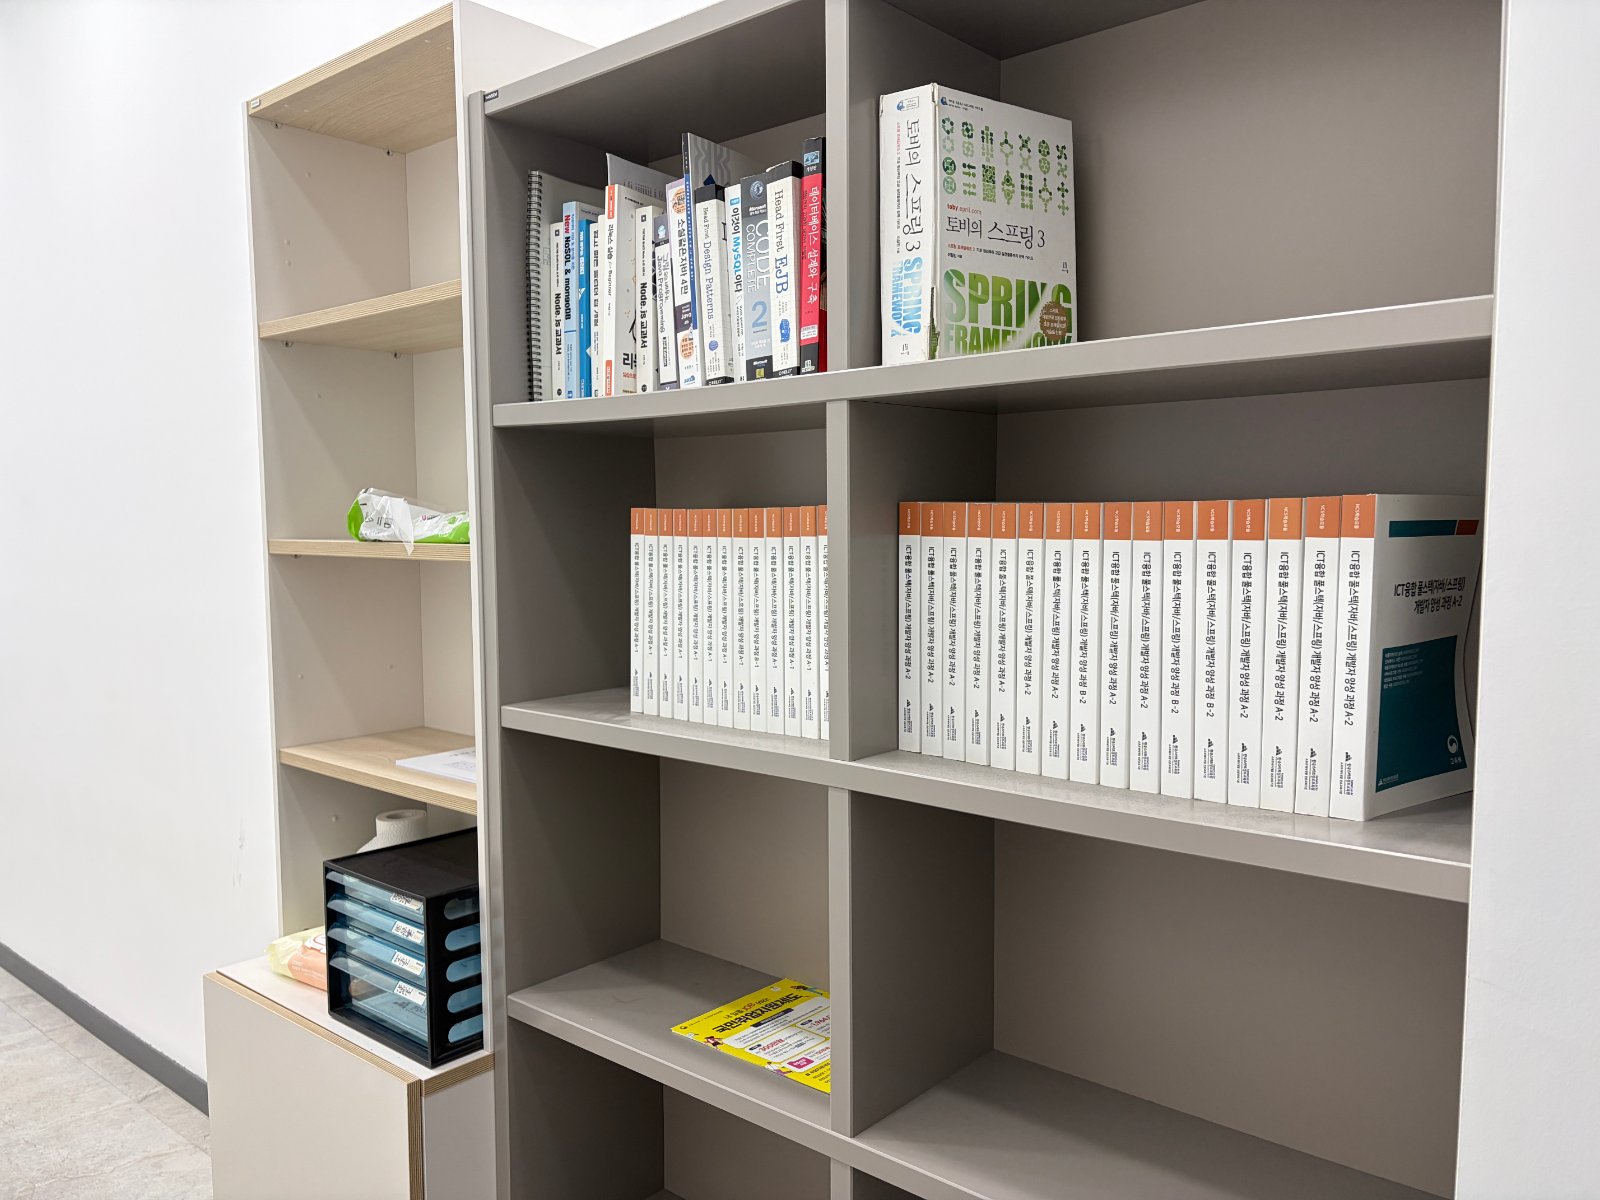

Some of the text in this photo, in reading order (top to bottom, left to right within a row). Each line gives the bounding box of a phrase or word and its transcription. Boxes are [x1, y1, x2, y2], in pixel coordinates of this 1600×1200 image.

[904, 119, 921, 167] 토비의
[902, 172, 924, 235] 스프링
[702, 207, 710, 223] Head
[807, 186, 819, 245] 데이터베이스
[774, 189, 788, 294] Head First EJB
[946, 216, 1045, 249] 토비의 스프링 3
[731, 207, 743, 293] 이것이 MySQL이다
[755, 219, 771, 290] CODE
[905, 241, 921, 252] 3
[702, 241, 713, 274] Design
[746, 224, 757, 293] COMPLETE
[807, 247, 819, 278] 설계와
[680, 278, 689, 295] 4판
[903, 256, 924, 335] SPRING
[657, 278, 665, 333] Programming
[705, 277, 715, 320] Patterns
[944, 268, 1073, 335] SPRING
[640, 282, 648, 348] Node.js 교과서
[751, 300, 767, 328] 2
[904, 544, 912, 566] ICT융합
[1141, 551, 1151, 577] ICT융합
[1172, 551, 1182, 577] ICT융합
[1314, 550, 1326, 578] ICT융합
[1206, 551, 1216, 578] ICT융합
[1241, 552, 1252, 579] ICT융합
[1278, 551, 1289, 579] ICT융합
[1348, 550, 1360, 579] ICT융합
[1394, 580, 1417, 597] ICT융합
[1414, 594, 1462, 615] 개발자 양성 과정 A-2
[633, 621, 639, 632] 양성
[904, 623, 912, 641] 개발자
[633, 632, 639, 642] 과정
[753, 633, 759, 644] 양성
[805, 635, 811, 647] 양성
[753, 645, 759, 656] 과정
[805, 648, 812, 659] 과정
[904, 642, 911, 654] 양성
[1140, 643, 1150, 664] 개발자
[1170, 644, 1180, 666] 개발자
[1205, 646, 1215, 668] 개발자
[904, 654, 911, 667] 과정
[1239, 648, 1250, 671] 개발자
[1275, 650, 1286, 673] 개발자
[1310, 650, 1322, 673] 개발자
[1345, 652, 1357, 676] 개발자
[1139, 665, 1149, 679] 양성
[1170, 666, 1180, 681] 양성
[1205, 669, 1215, 684] 양성
[1239, 672, 1250, 687] 양성
[1139, 680, 1149, 694] 과정
[1170, 682, 1180, 696] 과정
[1274, 674, 1285, 689] 양성
[1309, 675, 1321, 690] 양성
[1344, 677, 1356, 693] 양성
[1204, 684, 1215, 699] 과정
[1238, 688, 1250, 703] 과정
[1273, 690, 1285, 705] 과정
[1308, 691, 1320, 707] 과정
[1140, 695, 1148, 708] A-2
[1171, 699, 1179, 714] B-2
[1206, 702, 1214, 717] B-2
[1343, 694, 1355, 710] 과정
[1240, 704, 1248, 718] A-2
[1274, 706, 1284, 721] A-2
[1309, 707, 1319, 722] A-2
[1344, 710, 1354, 726] A-2
[712, 993, 803, 1033] 국민취업지원제도
